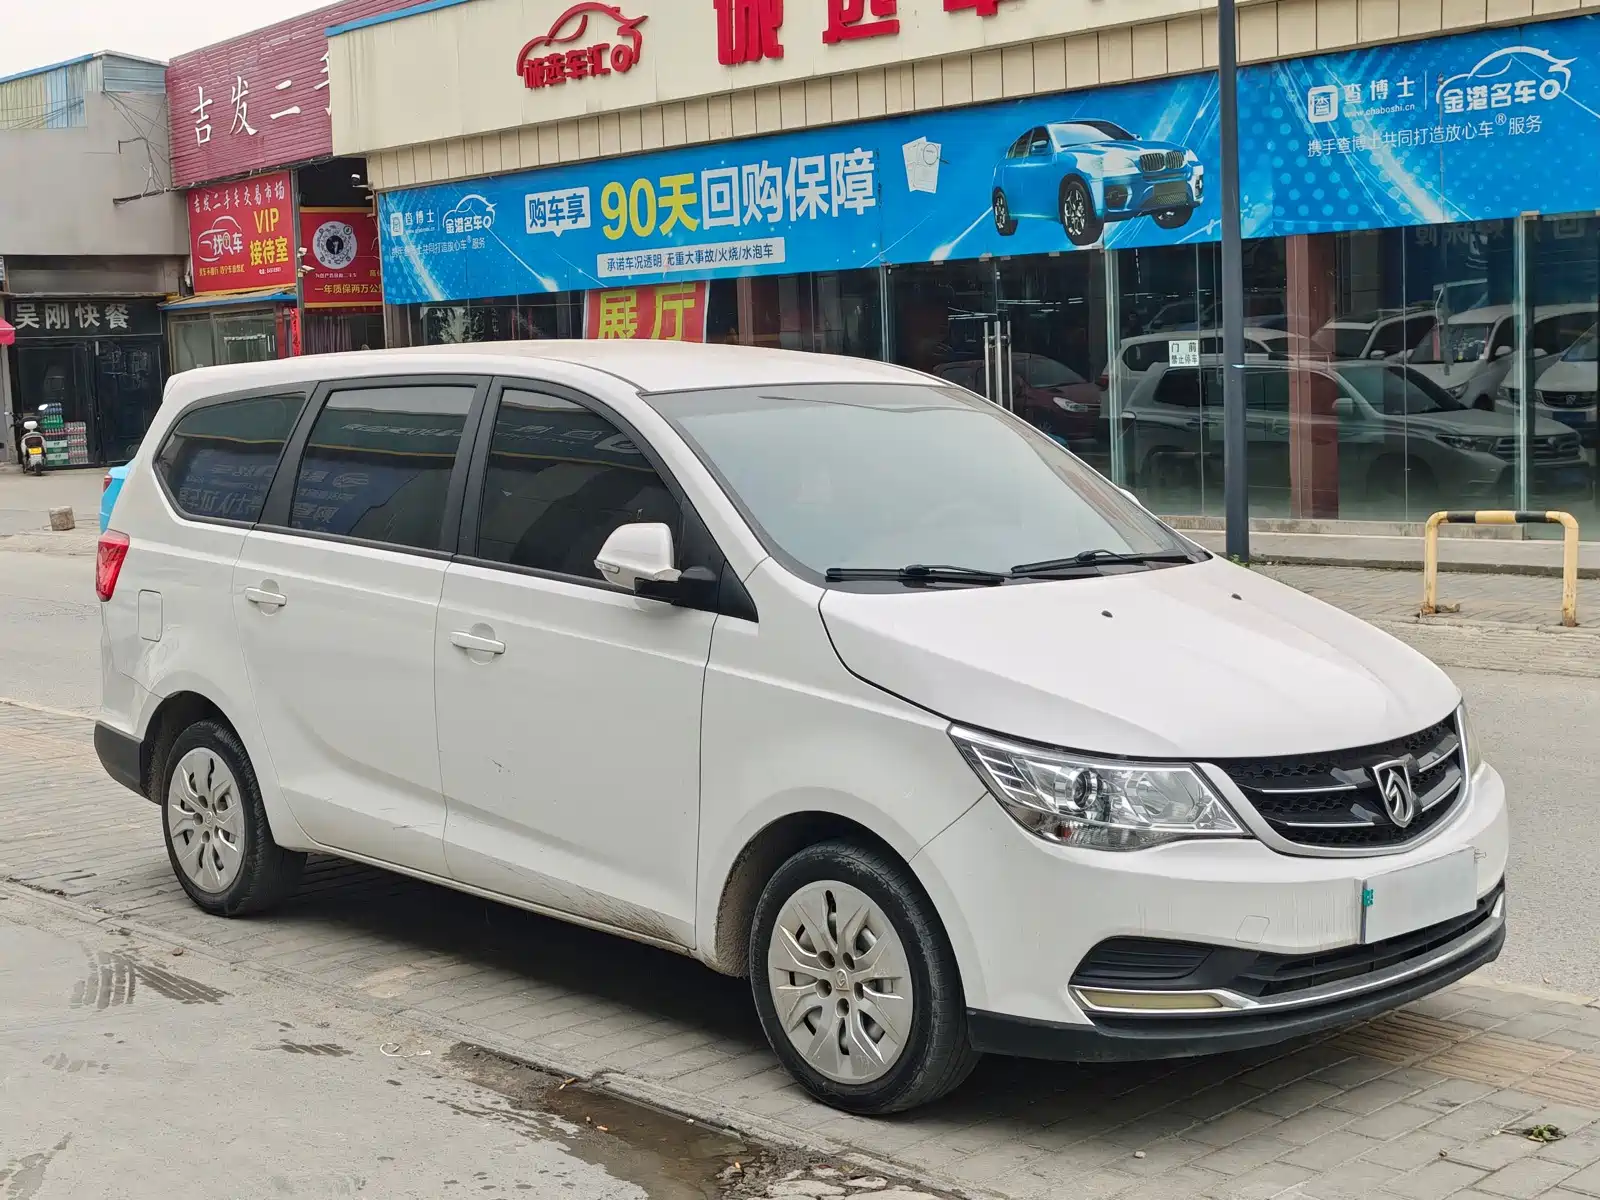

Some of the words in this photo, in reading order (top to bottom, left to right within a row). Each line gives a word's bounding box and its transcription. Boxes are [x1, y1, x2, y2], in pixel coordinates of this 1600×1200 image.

[1342, 75, 1415, 105] 查博士
[193, 180, 285, 214] 吉发二手车交易市场
[528, 193, 586, 228] 购车享
[253, 207, 280, 234] VIP
[249, 235, 289, 267] 接待室
[607, 252, 662, 272] 承诺车况透明
[666, 242, 774, 267] 无重大事故/火烧/水泡车
[15, 302, 130, 330] 吴刚快餐
[598, 283, 696, 341] 展厅
